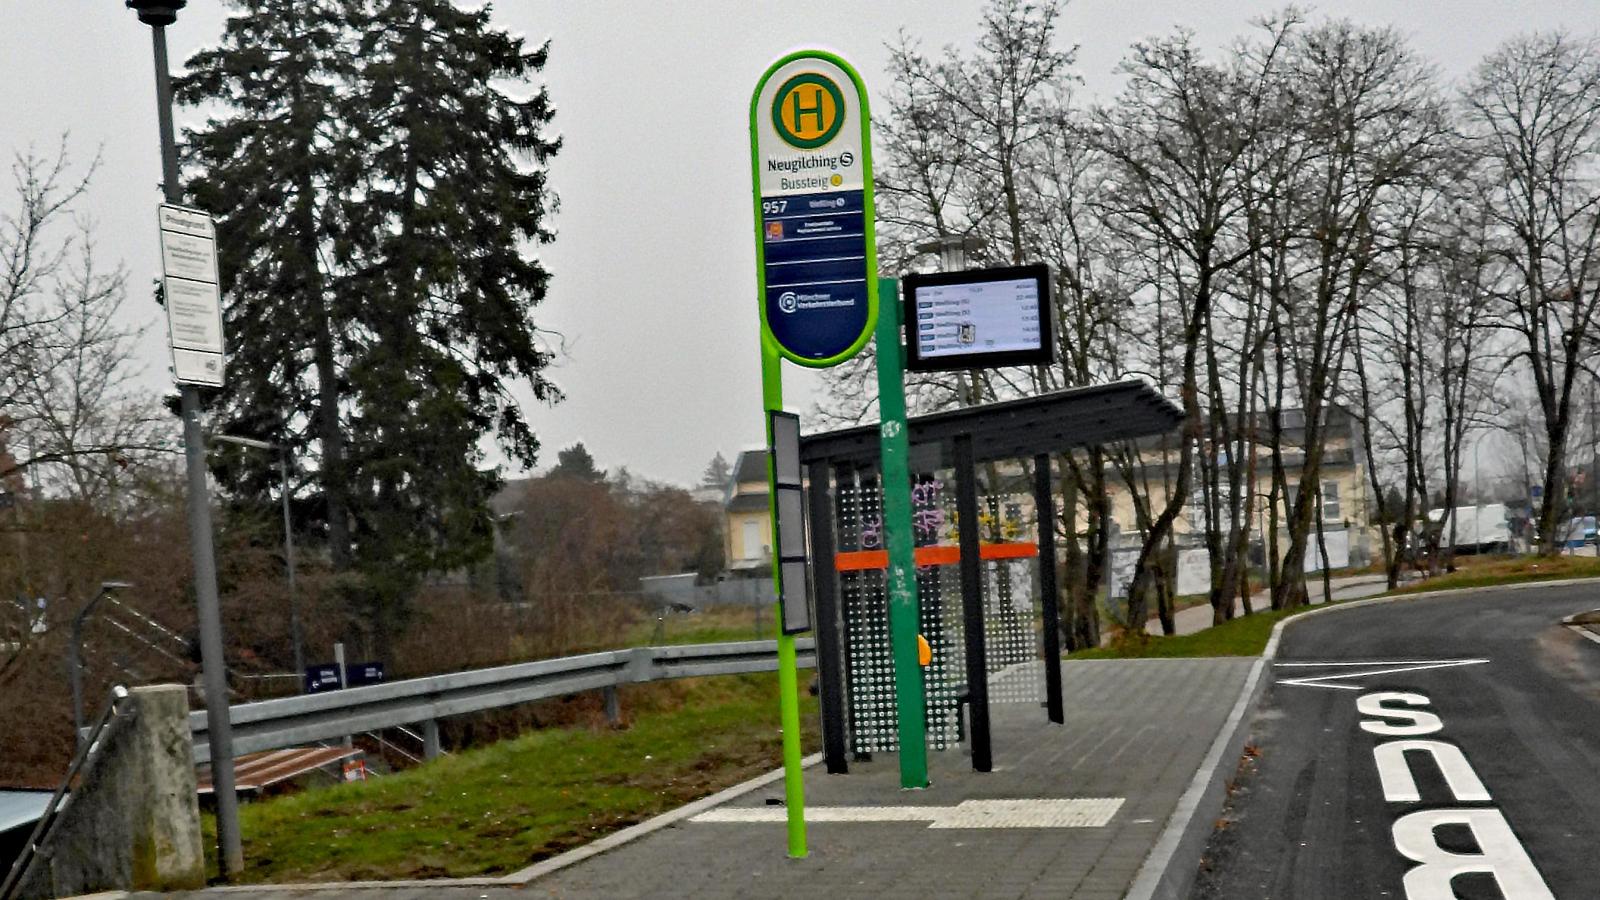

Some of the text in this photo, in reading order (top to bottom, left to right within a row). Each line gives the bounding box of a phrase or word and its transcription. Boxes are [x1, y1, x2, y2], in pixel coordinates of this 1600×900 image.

[793, 90, 823, 132] H
[768, 155, 837, 173] Neugilching
[781, 177, 828, 190] Bussteig
[762, 201, 788, 214] 957
[1356, 691, 1556, 900] BUS
